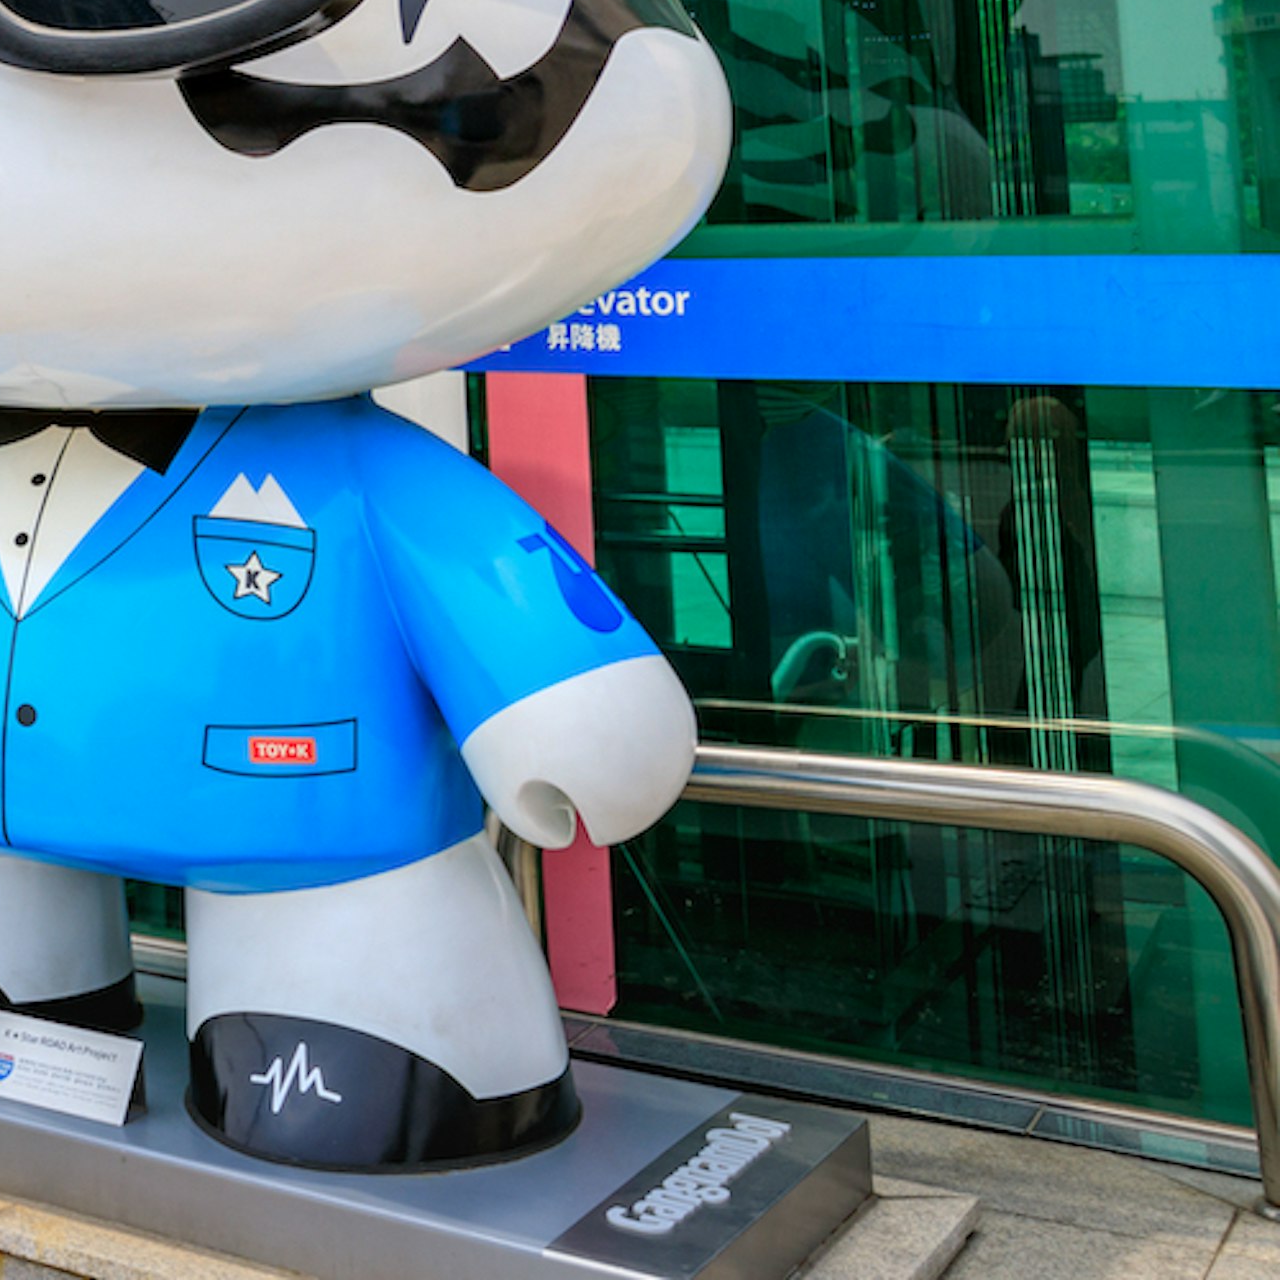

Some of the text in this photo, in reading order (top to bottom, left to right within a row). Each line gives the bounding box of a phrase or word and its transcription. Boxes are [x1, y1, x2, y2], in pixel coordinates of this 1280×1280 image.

[245, 569, 261, 591] K
[40, 1036, 67, 1051] ROAD
[83, 1047, 119, 1063] Project
[605, 1111, 792, 1235] GangnamDol
